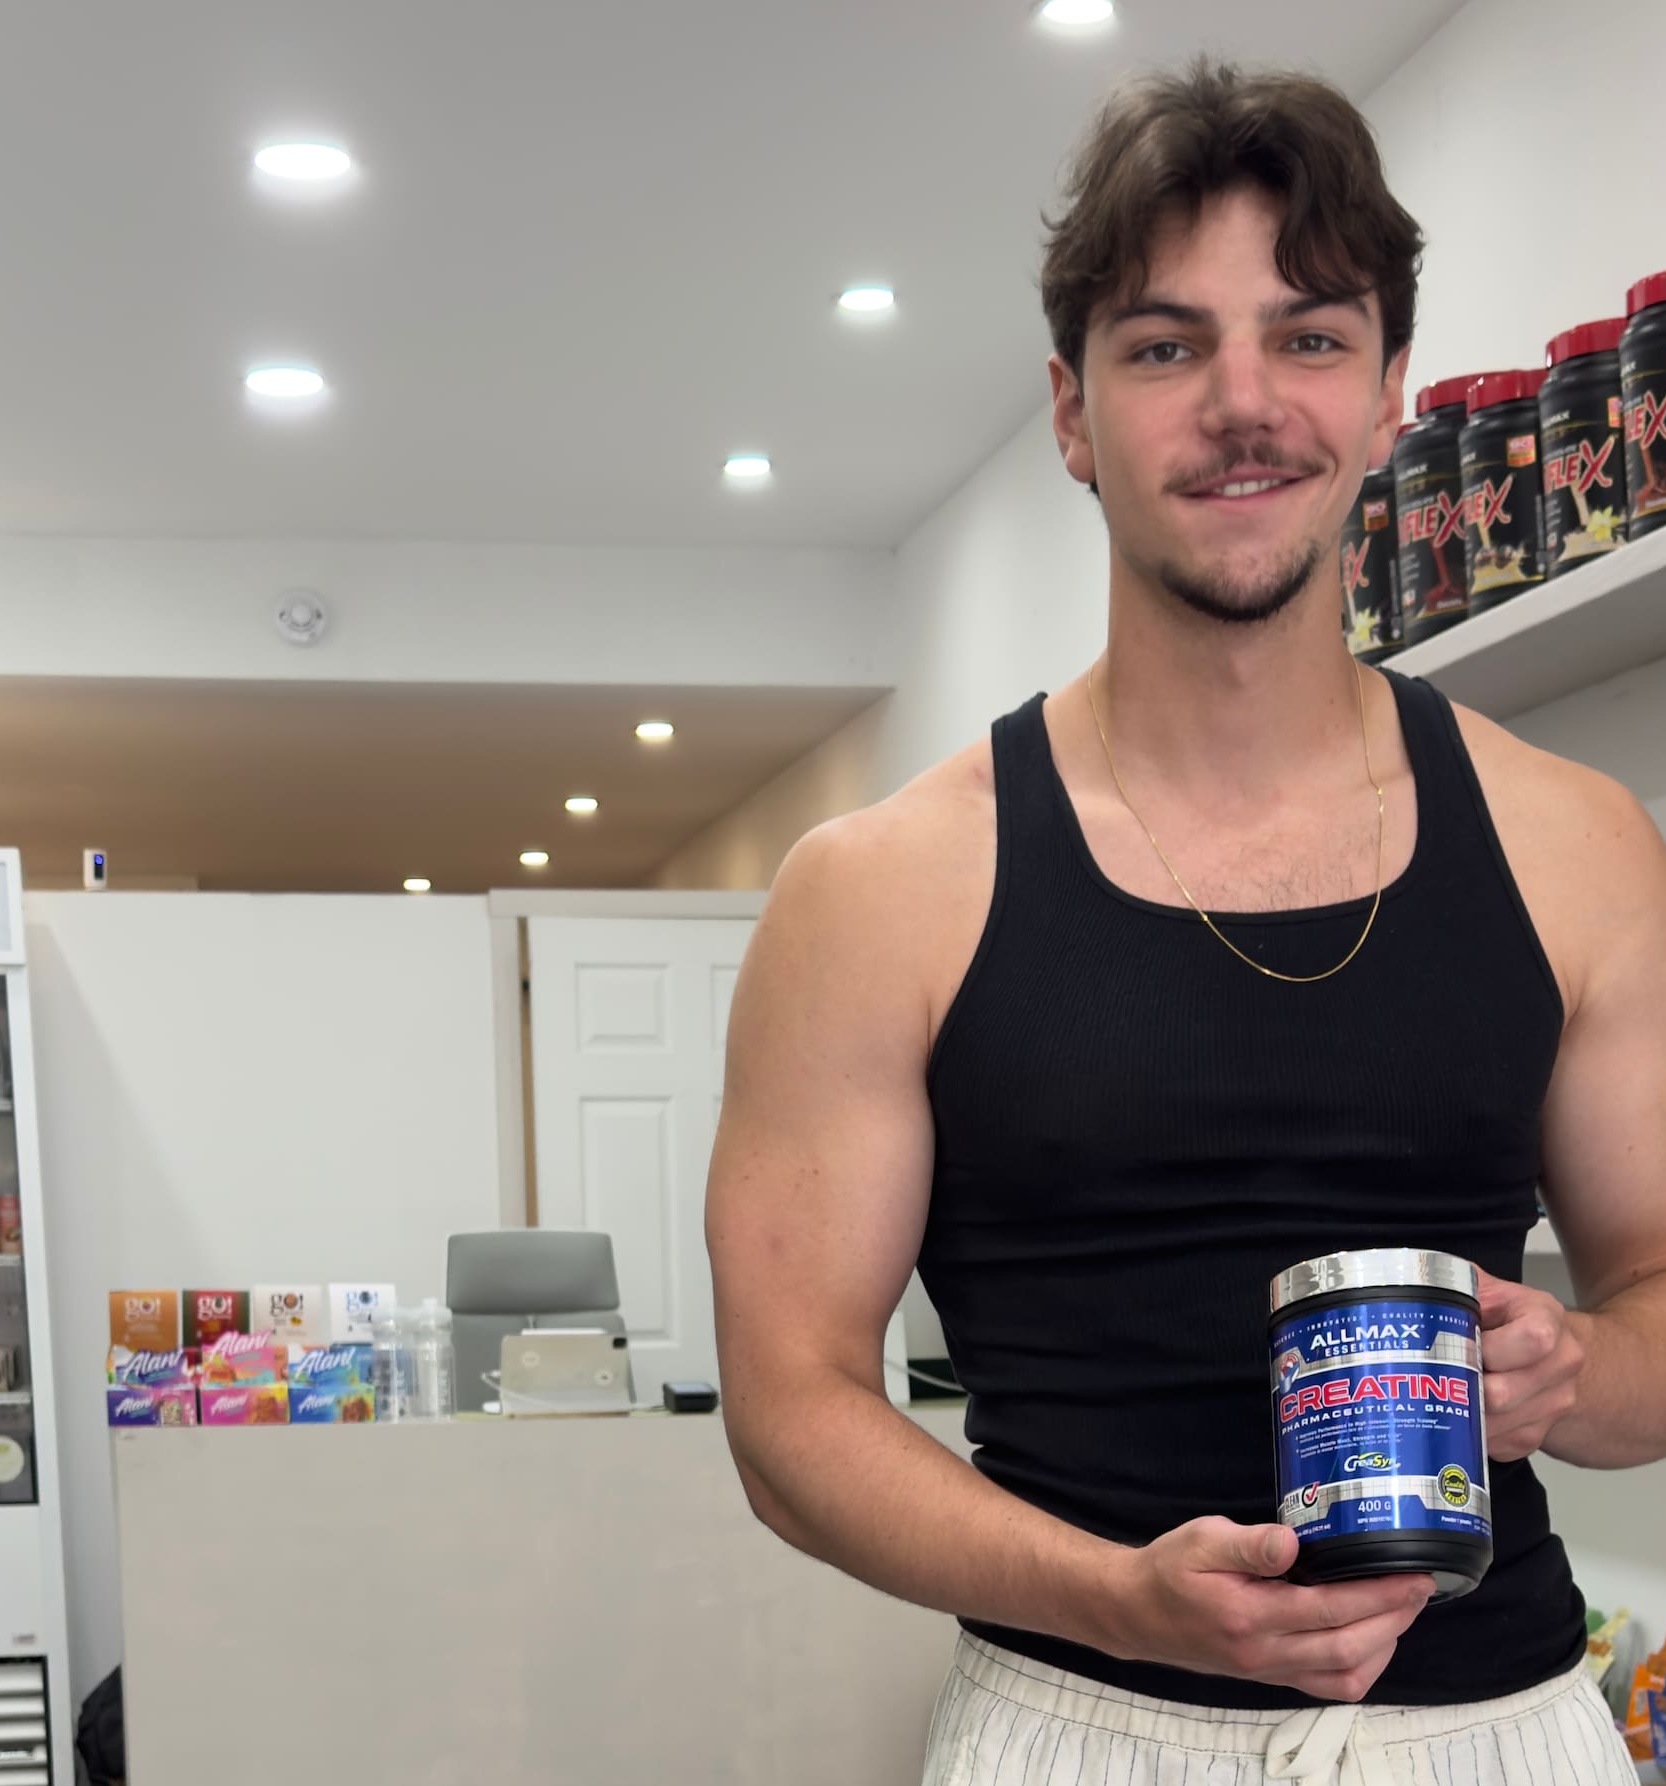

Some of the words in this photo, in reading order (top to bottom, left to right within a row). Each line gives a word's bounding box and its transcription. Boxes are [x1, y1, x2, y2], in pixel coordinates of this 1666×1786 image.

[1311, 1324, 1421, 1350] ALLMAX
[1325, 1340, 1410, 1357] ESSENTIALS
[1280, 1374, 1470, 1422] CREATINE
[1282, 1405, 1416, 1435] PHARMACEUTICAL
[1425, 1404, 1469, 1418] GRADE
[1358, 1501, 1382, 1513] 400
[1384, 1502, 1391, 1511] G
